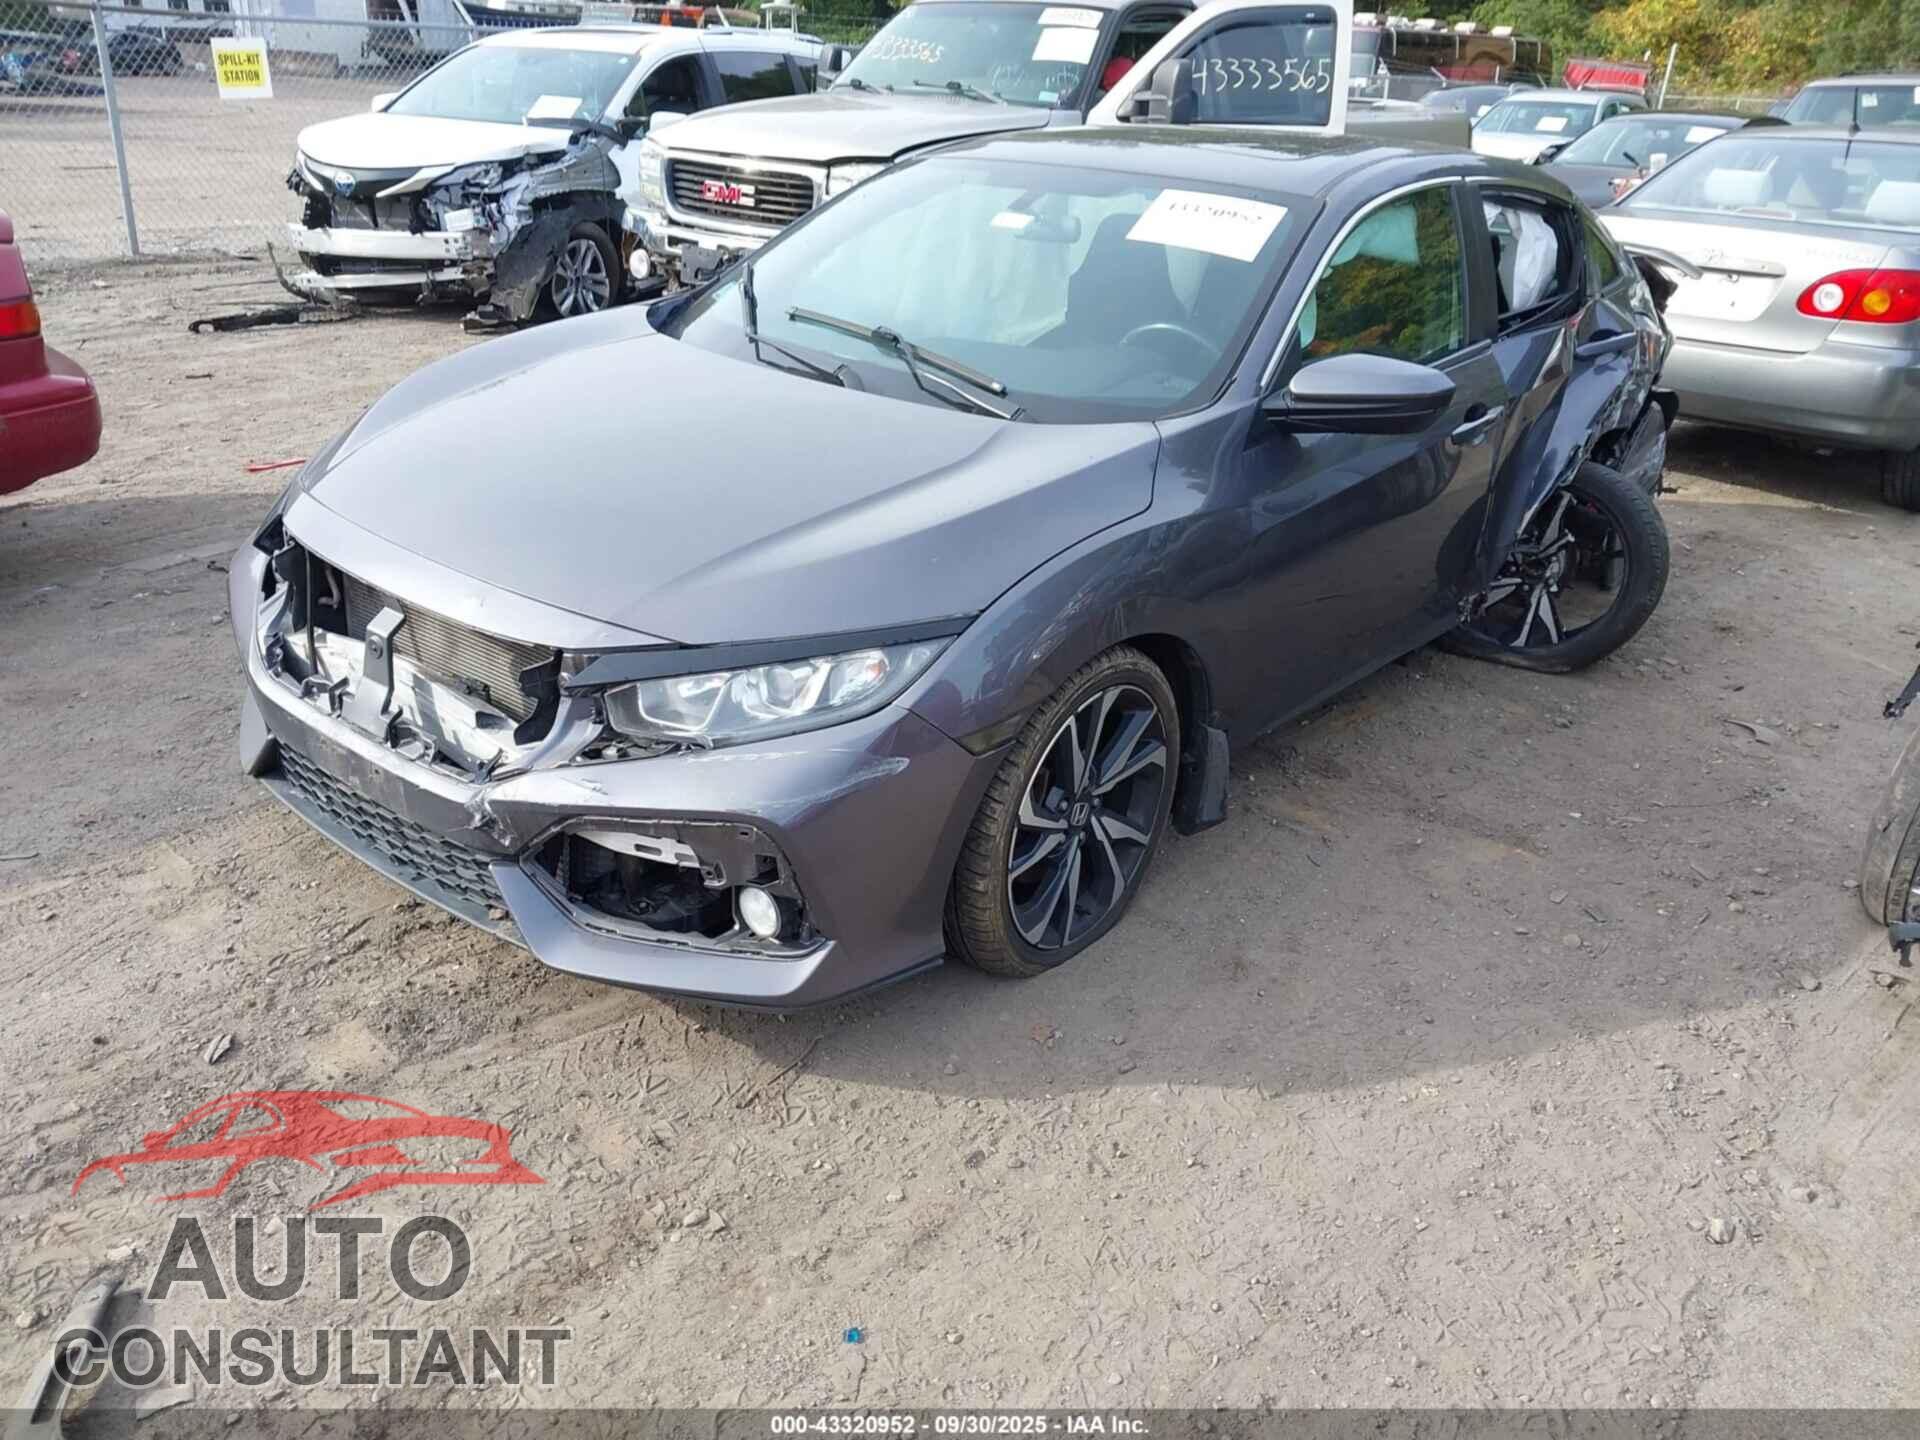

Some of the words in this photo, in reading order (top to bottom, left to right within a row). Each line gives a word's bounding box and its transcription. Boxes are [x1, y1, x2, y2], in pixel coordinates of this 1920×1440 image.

[218, 53, 260, 66] SPILL-KIT
[224, 70, 260, 82] STATION
[1192, 57, 1331, 96] 43333565
[703, 180, 755, 207] GMC
